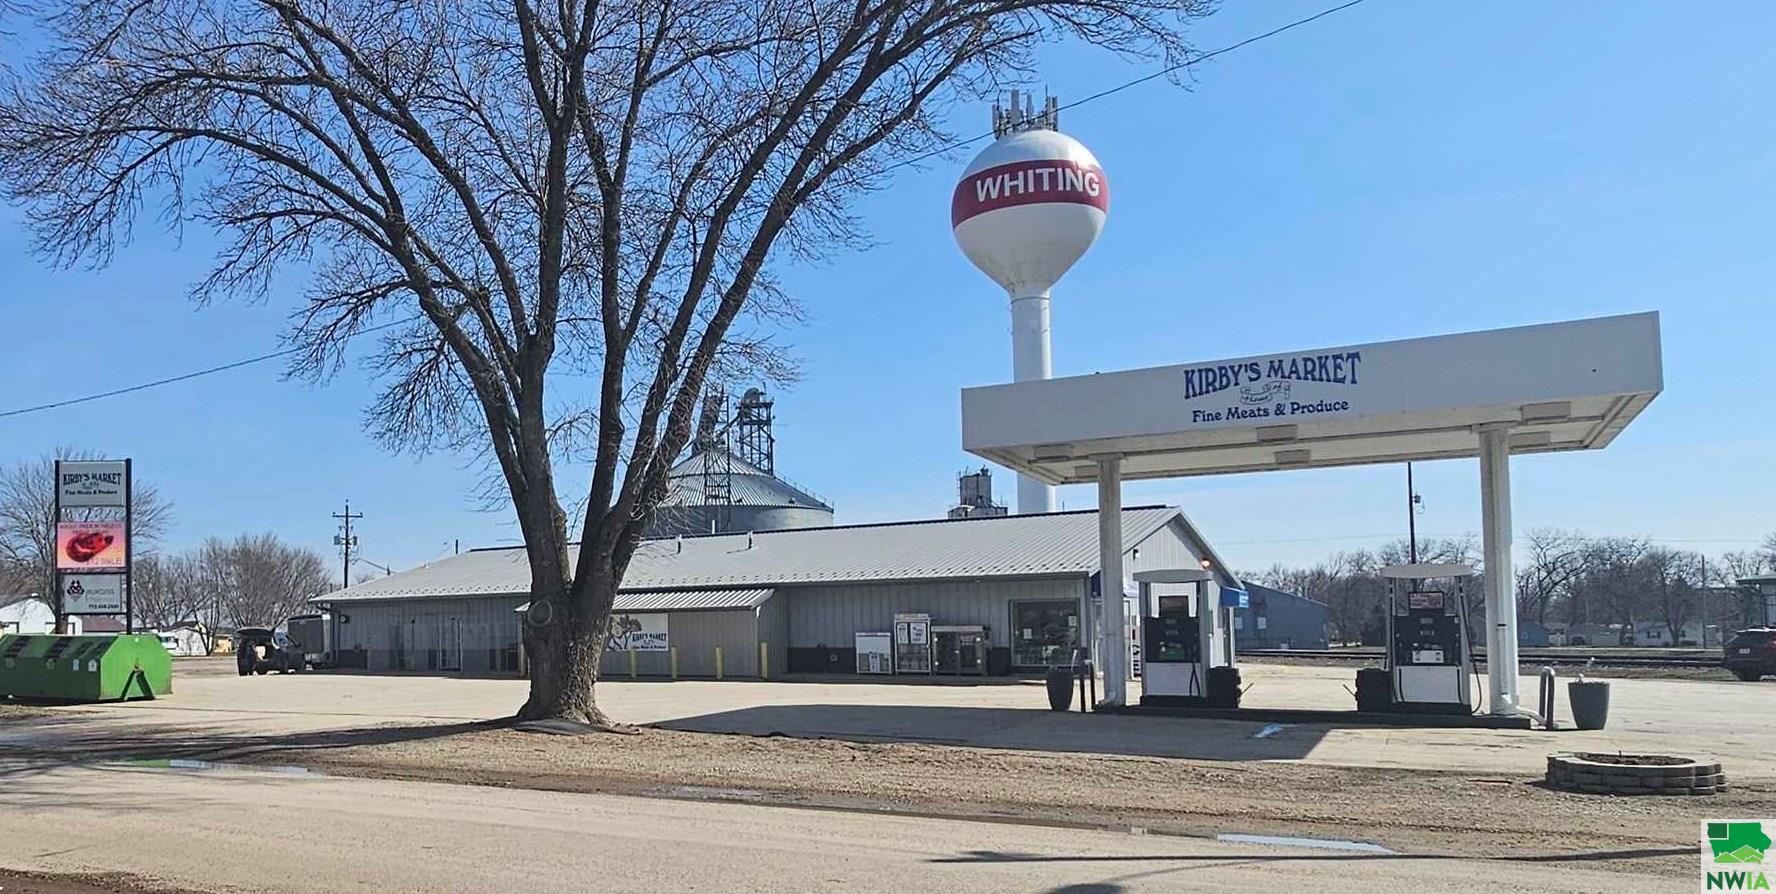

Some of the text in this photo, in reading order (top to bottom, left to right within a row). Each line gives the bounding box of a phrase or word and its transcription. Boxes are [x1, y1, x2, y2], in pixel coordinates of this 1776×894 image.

[976, 167, 1100, 203] WHITING
[1183, 361, 1262, 400] KIRBY'S
[1266, 351, 1362, 385] MARKET
[1192, 399, 1350, 423] Fine Meats & Produce
[92, 472, 121, 486] MARKET
